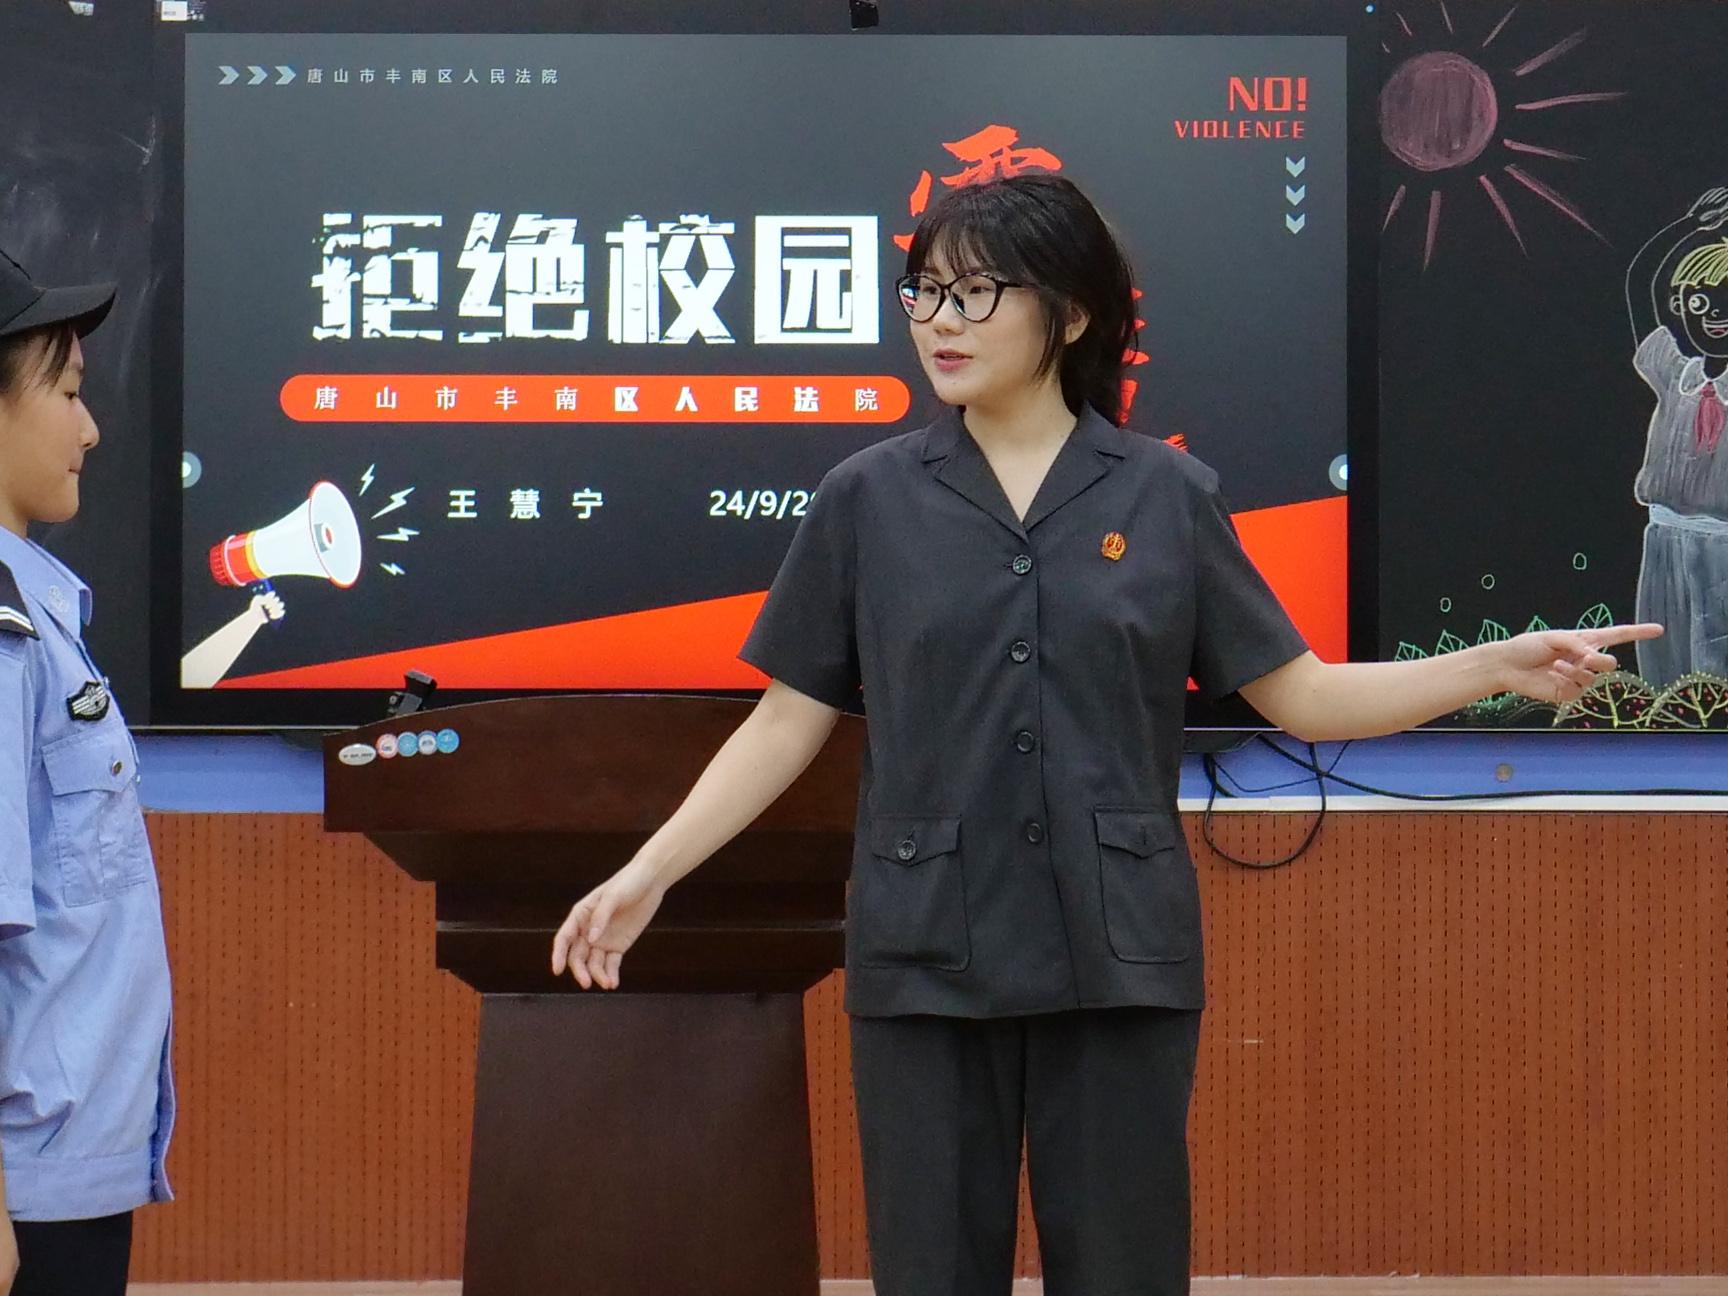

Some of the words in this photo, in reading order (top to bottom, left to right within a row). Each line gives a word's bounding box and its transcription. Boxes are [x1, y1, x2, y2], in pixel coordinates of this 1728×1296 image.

[307, 67, 559, 85] 唐山市丰南区人民法院
[1228, 76, 1308, 112] NO!
[1173, 119, 1306, 139] VIOLENCE
[311, 212, 880, 344] 拒绝校园
[313, 385, 879, 412] 唐山市丰南区人民法院
[447, 487, 604, 520] 王慧宁
[709, 490, 817, 520] 24/9/2
